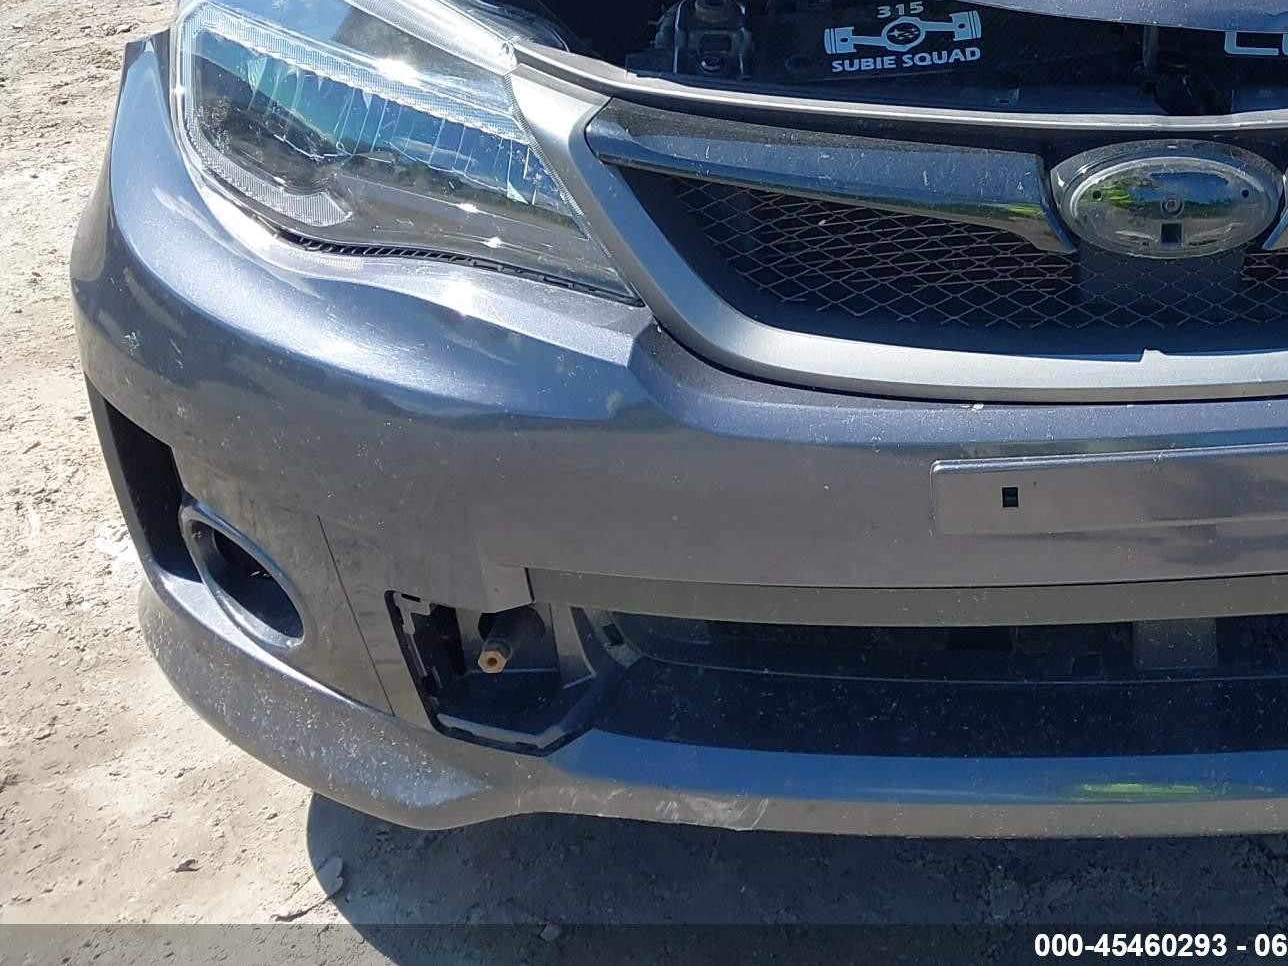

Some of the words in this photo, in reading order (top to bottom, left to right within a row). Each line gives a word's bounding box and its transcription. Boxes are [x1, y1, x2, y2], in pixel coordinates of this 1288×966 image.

[877, 1, 925, 18] 315
[831, 56, 897, 73] SUBIE
[902, 47, 981, 68] SQUAD
